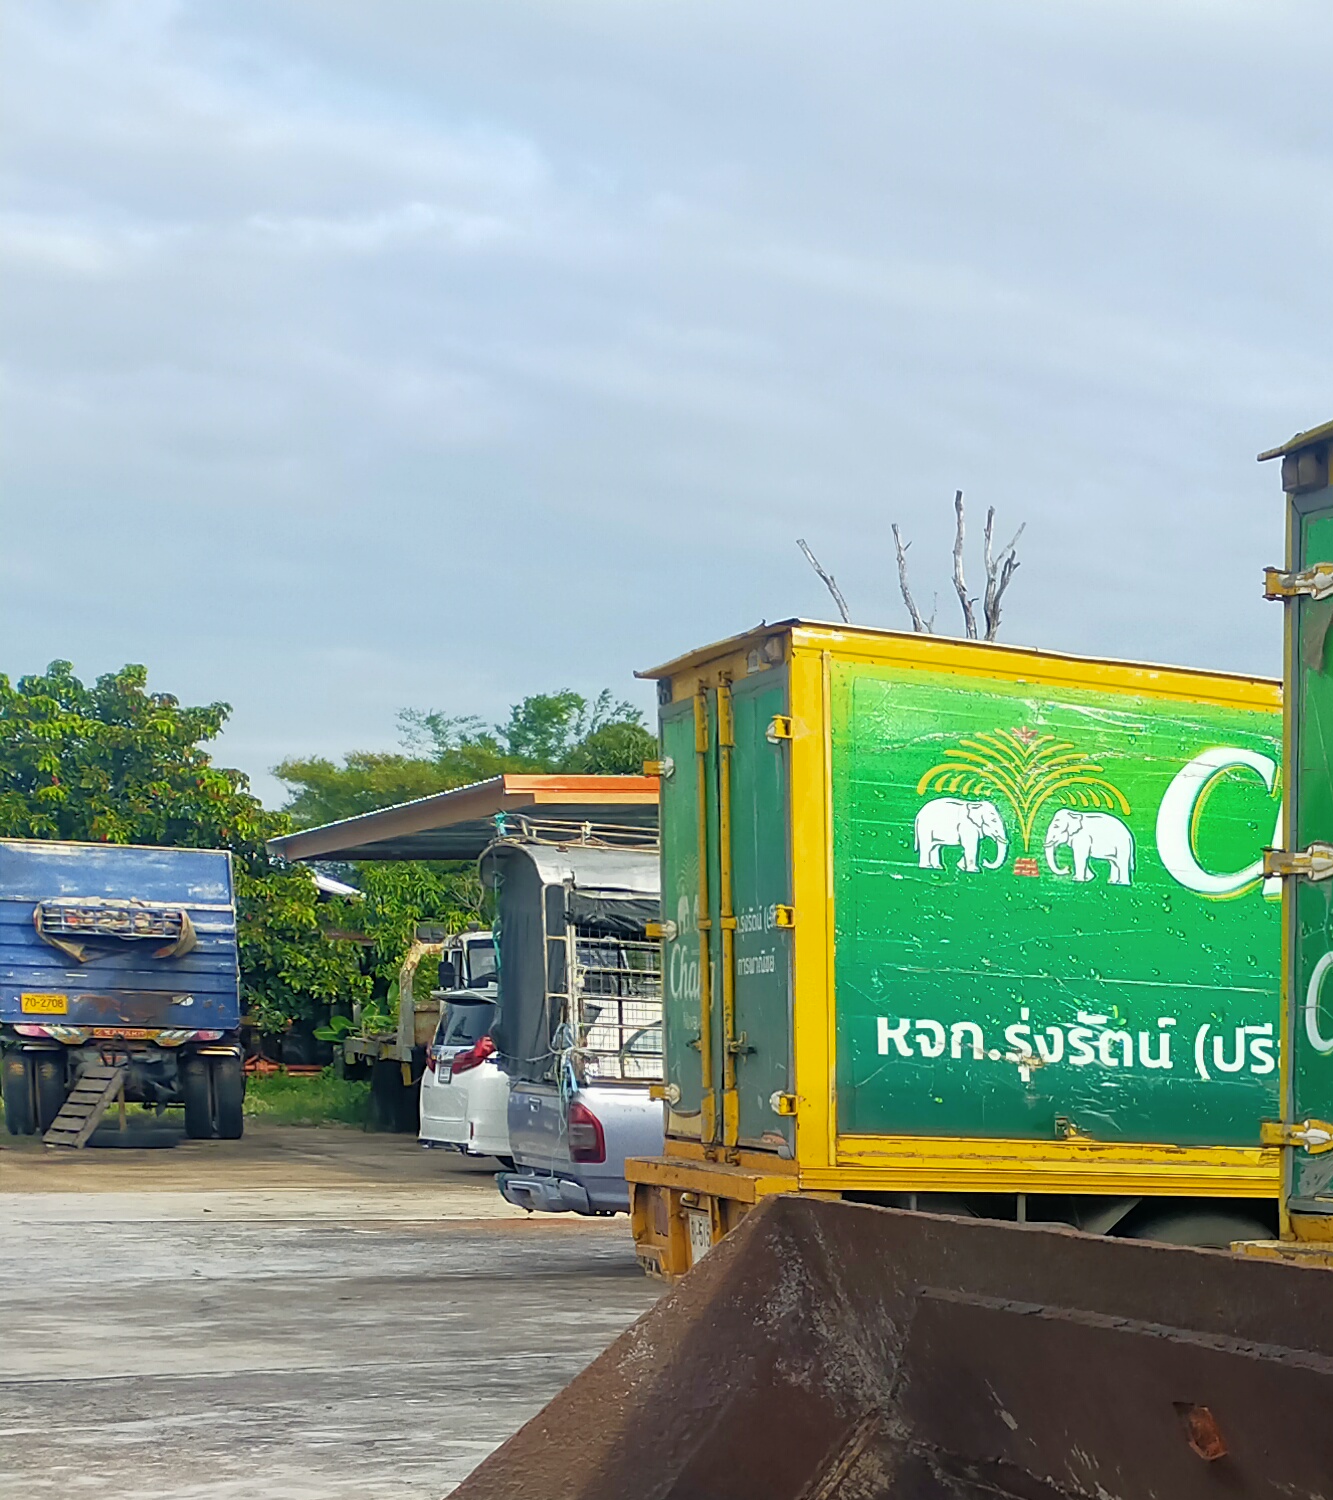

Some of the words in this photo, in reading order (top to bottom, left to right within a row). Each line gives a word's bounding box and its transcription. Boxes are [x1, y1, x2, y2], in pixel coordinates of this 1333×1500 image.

[24, 997, 64, 1008] 70-2708
[876, 1007, 1177, 1082] หจก.รุ่งรัตน์
[1194, 1022, 1281, 1081] (ปรี
